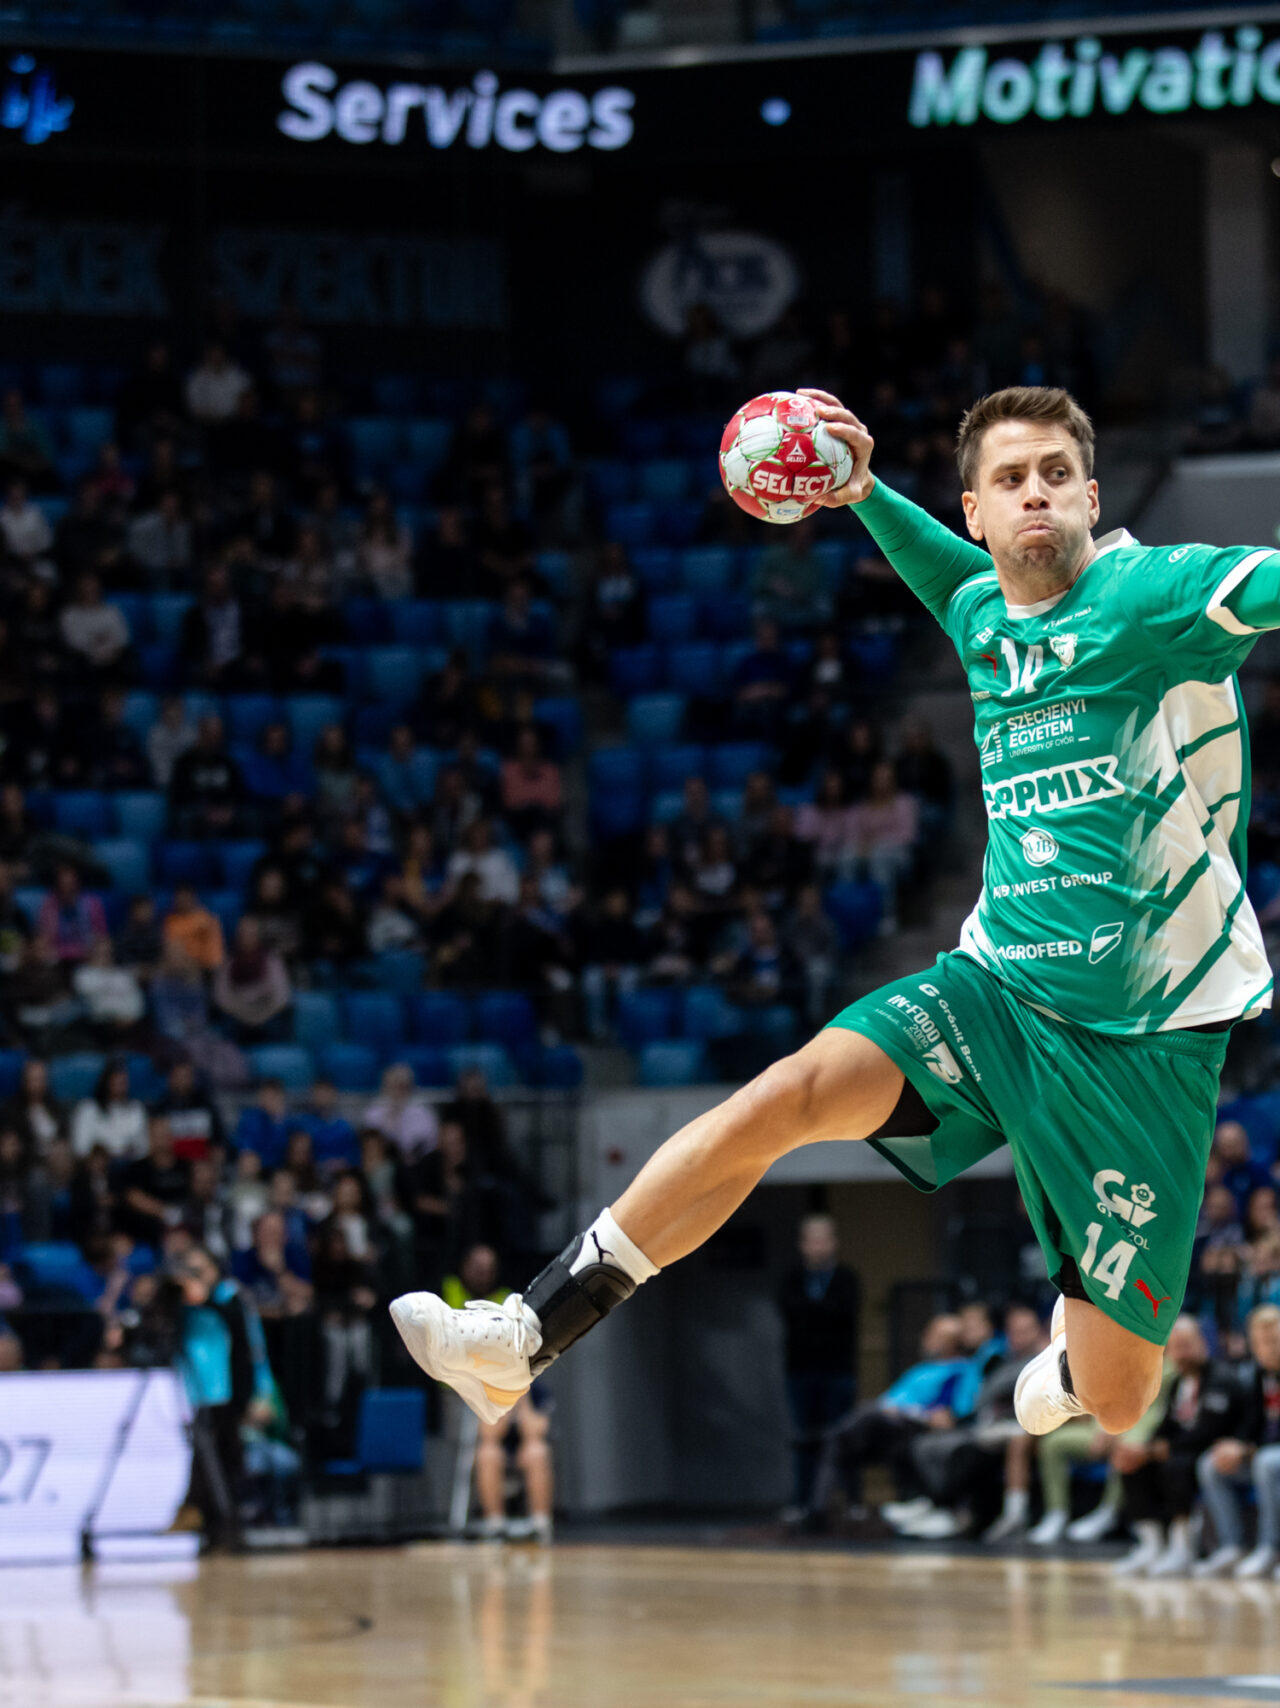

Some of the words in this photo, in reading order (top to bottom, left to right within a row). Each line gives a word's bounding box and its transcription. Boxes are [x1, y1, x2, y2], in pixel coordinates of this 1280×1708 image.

[275, 61, 635, 151] Services
[786, 455, 807, 464] SELECT
[753, 469, 832, 497] SELECT
[1000, 636, 1044, 697] 14
[1009, 718, 1073, 748] EGYETEM
[1009, 742, 1044, 759] UNIVERSITY
[1045, 741, 1055, 750] OF
[1011, 876, 1057, 897] INVEST
[1060, 871, 1113, 888] GROUP
[996, 940, 1083, 960] AGROFEED
[887, 994, 941, 1043] IN-FOOD
[960, 1045, 982, 1082] Bank
[1080, 1221, 1139, 1301] 14
